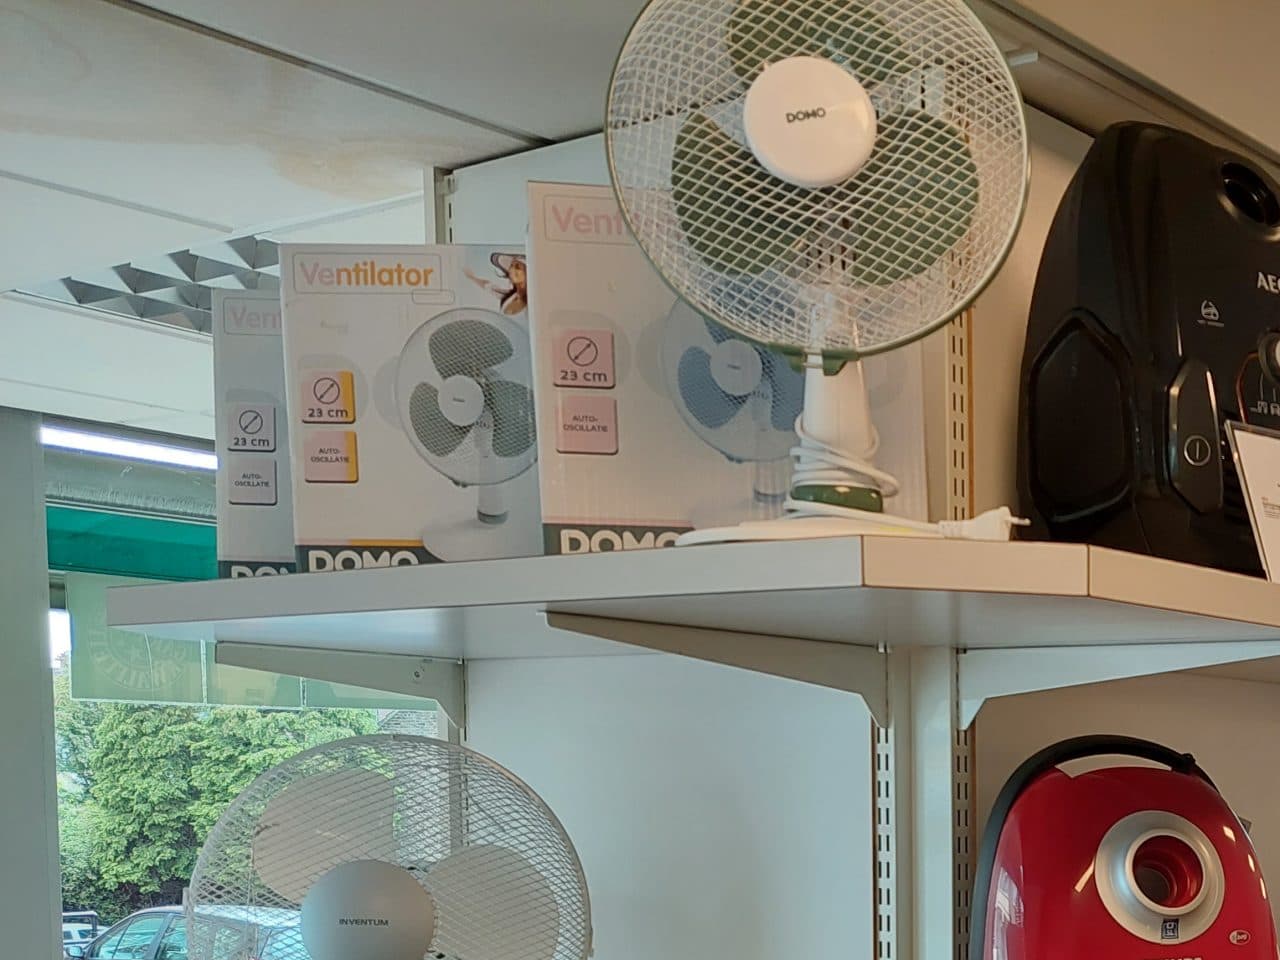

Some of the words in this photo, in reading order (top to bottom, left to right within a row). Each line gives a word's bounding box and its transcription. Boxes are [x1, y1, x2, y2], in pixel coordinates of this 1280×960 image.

[785, 107, 826, 123] DOMO
[300, 261, 433, 287] Ventilator
[560, 370, 579, 381] 23
[583, 371, 608, 383] cm
[307, 408, 323, 417] 23
[327, 409, 349, 418] cm
[233, 437, 249, 446] 23
[250, 438, 270, 447] cm
[339, 918, 389, 927] INVENTUM
